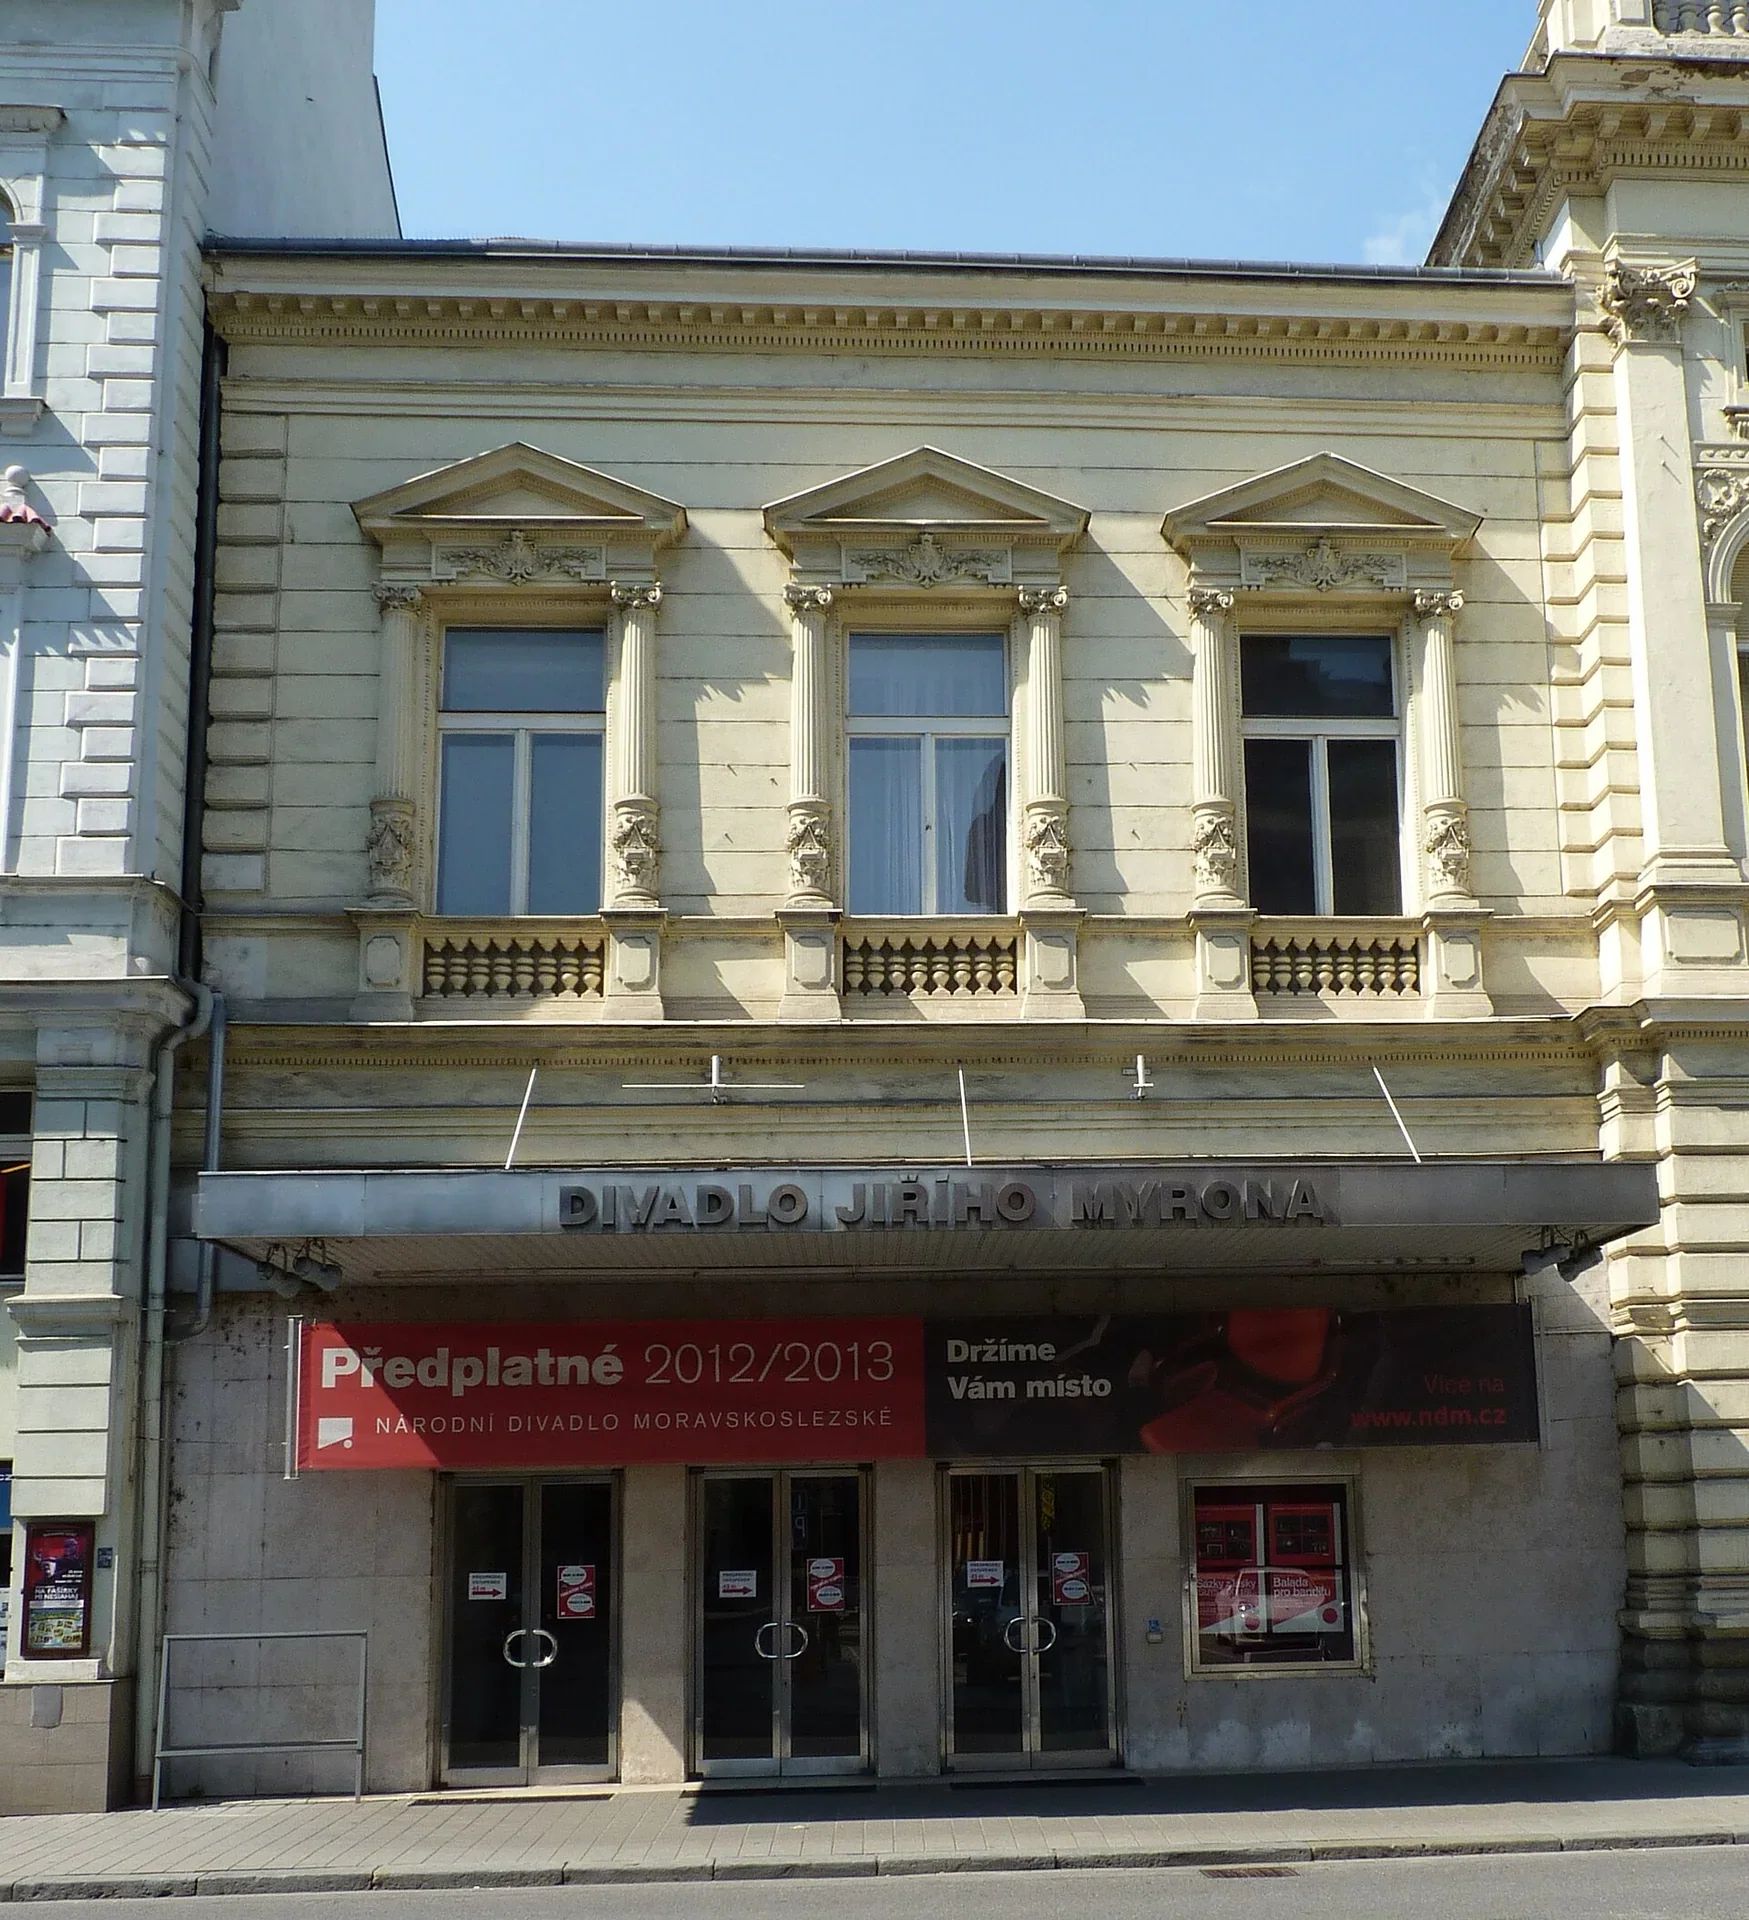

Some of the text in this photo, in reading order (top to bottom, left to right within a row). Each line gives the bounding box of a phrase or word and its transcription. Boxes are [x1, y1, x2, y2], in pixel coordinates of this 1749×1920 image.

[559, 1175, 1323, 1226] DIVADLO JIŘÍHO MYRONA
[947, 1338, 1057, 1363] Držíme
[321, 1341, 894, 1397] Předplatné 2012/2013
[947, 1373, 1112, 1399] Vám místo
[376, 1406, 893, 1434] NÁRODNÍ DIVADLO MORAVSKOSLEZSKÉ
[1349, 1406, 1506, 1428] www.ndm.cz
[1273, 1577, 1308, 1587] Balada
[1273, 1588, 1291, 1598] pro
